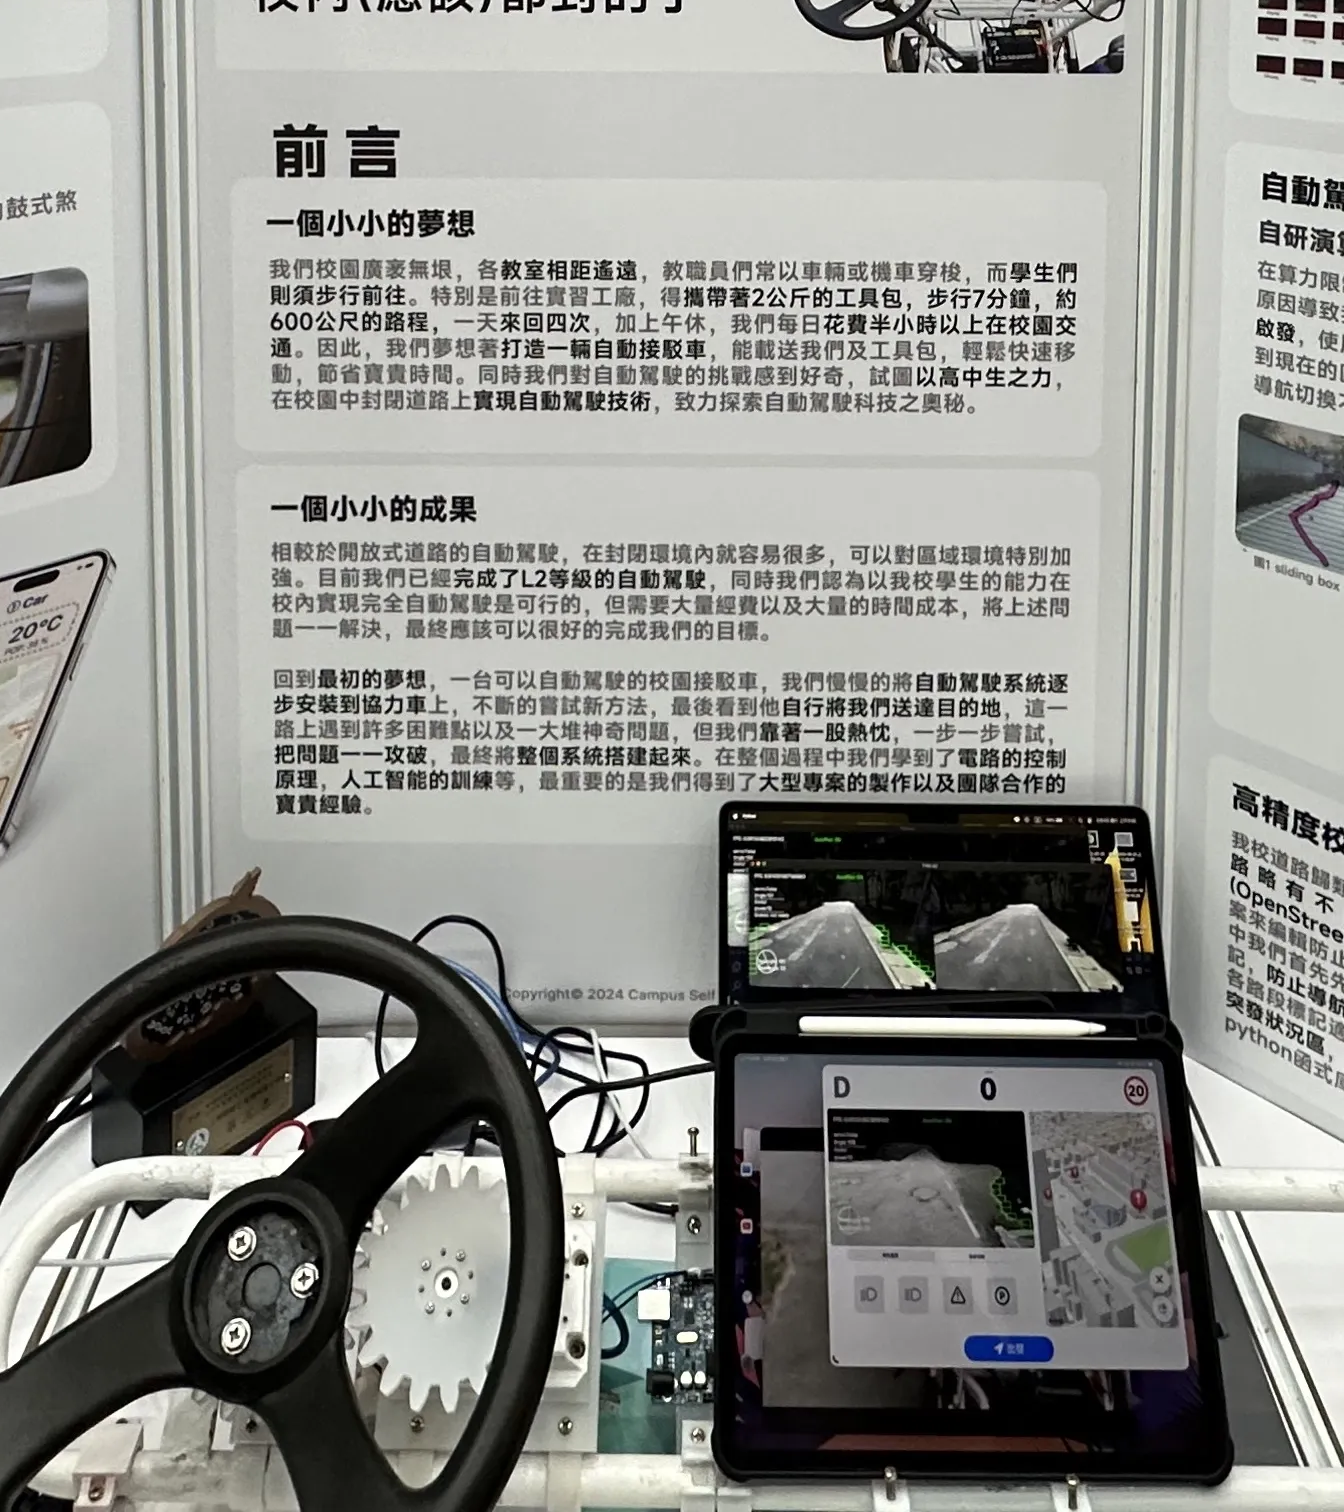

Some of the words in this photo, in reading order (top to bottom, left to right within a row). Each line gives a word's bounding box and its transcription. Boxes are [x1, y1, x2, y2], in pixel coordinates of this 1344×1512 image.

[273, 125, 400, 179] 前言
[267, 210, 475, 237] 一個小小的夢想
[271, 494, 477, 522] 一個小小的成果
[1318, 575, 1340, 591] box
[588, 989, 624, 1000] 2024
[629, 990, 684, 1002] Campus
[833, 1076, 850, 1099] D
[980, 1077, 997, 1101] 0
[1127, 1084, 1146, 1098] 20
